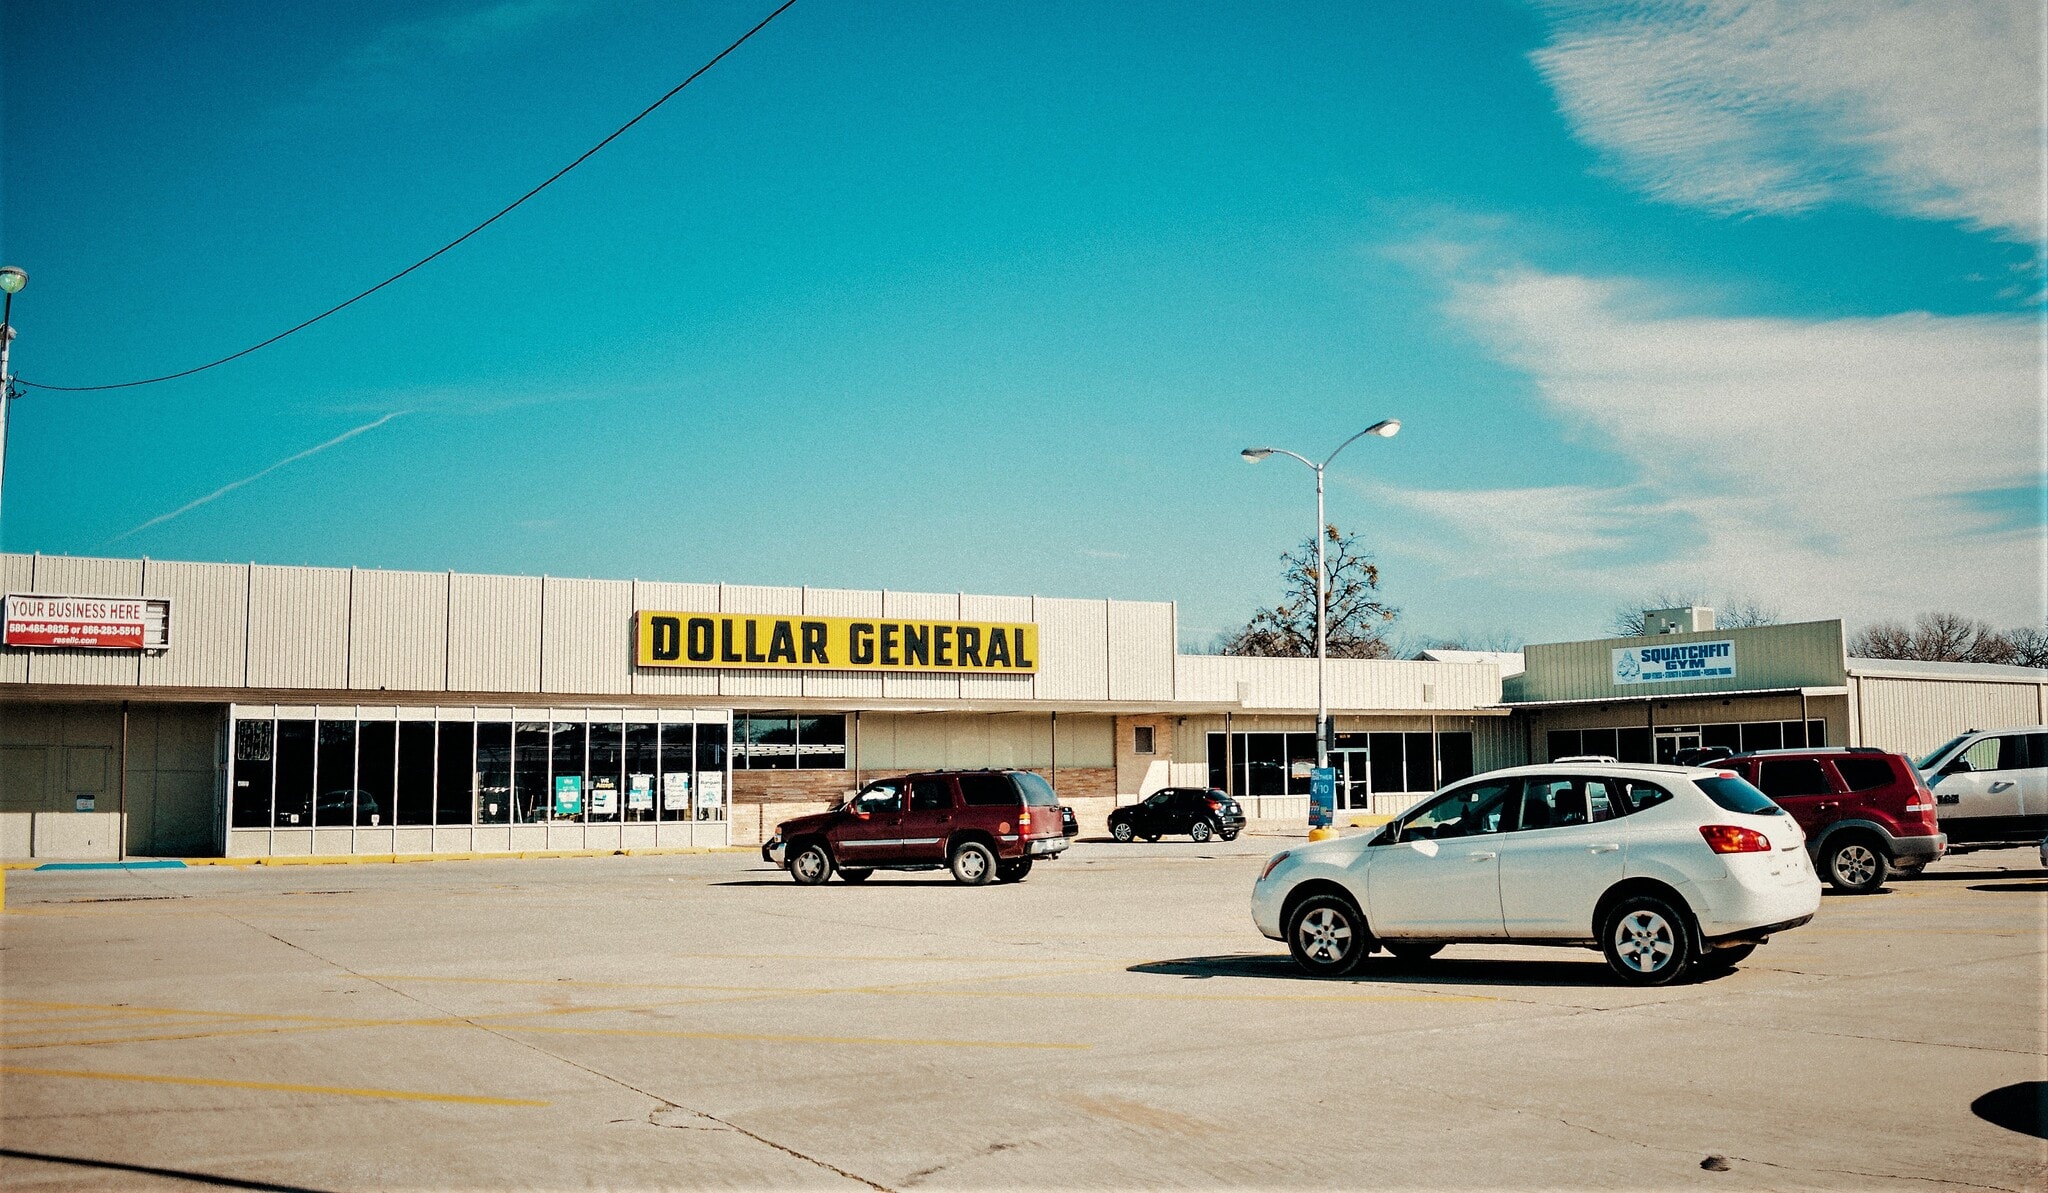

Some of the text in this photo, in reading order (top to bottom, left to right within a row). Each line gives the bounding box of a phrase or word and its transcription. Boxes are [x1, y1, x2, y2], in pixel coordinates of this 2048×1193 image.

[12, 601, 140, 620] YOUR BUSINESS HERE
[70, 626, 81, 635] or
[651, 616, 1033, 668] DOLLAR GENERAL
[1640, 643, 1731, 664] SQUATCHFIT
[1665, 658, 1706, 670] GYM
